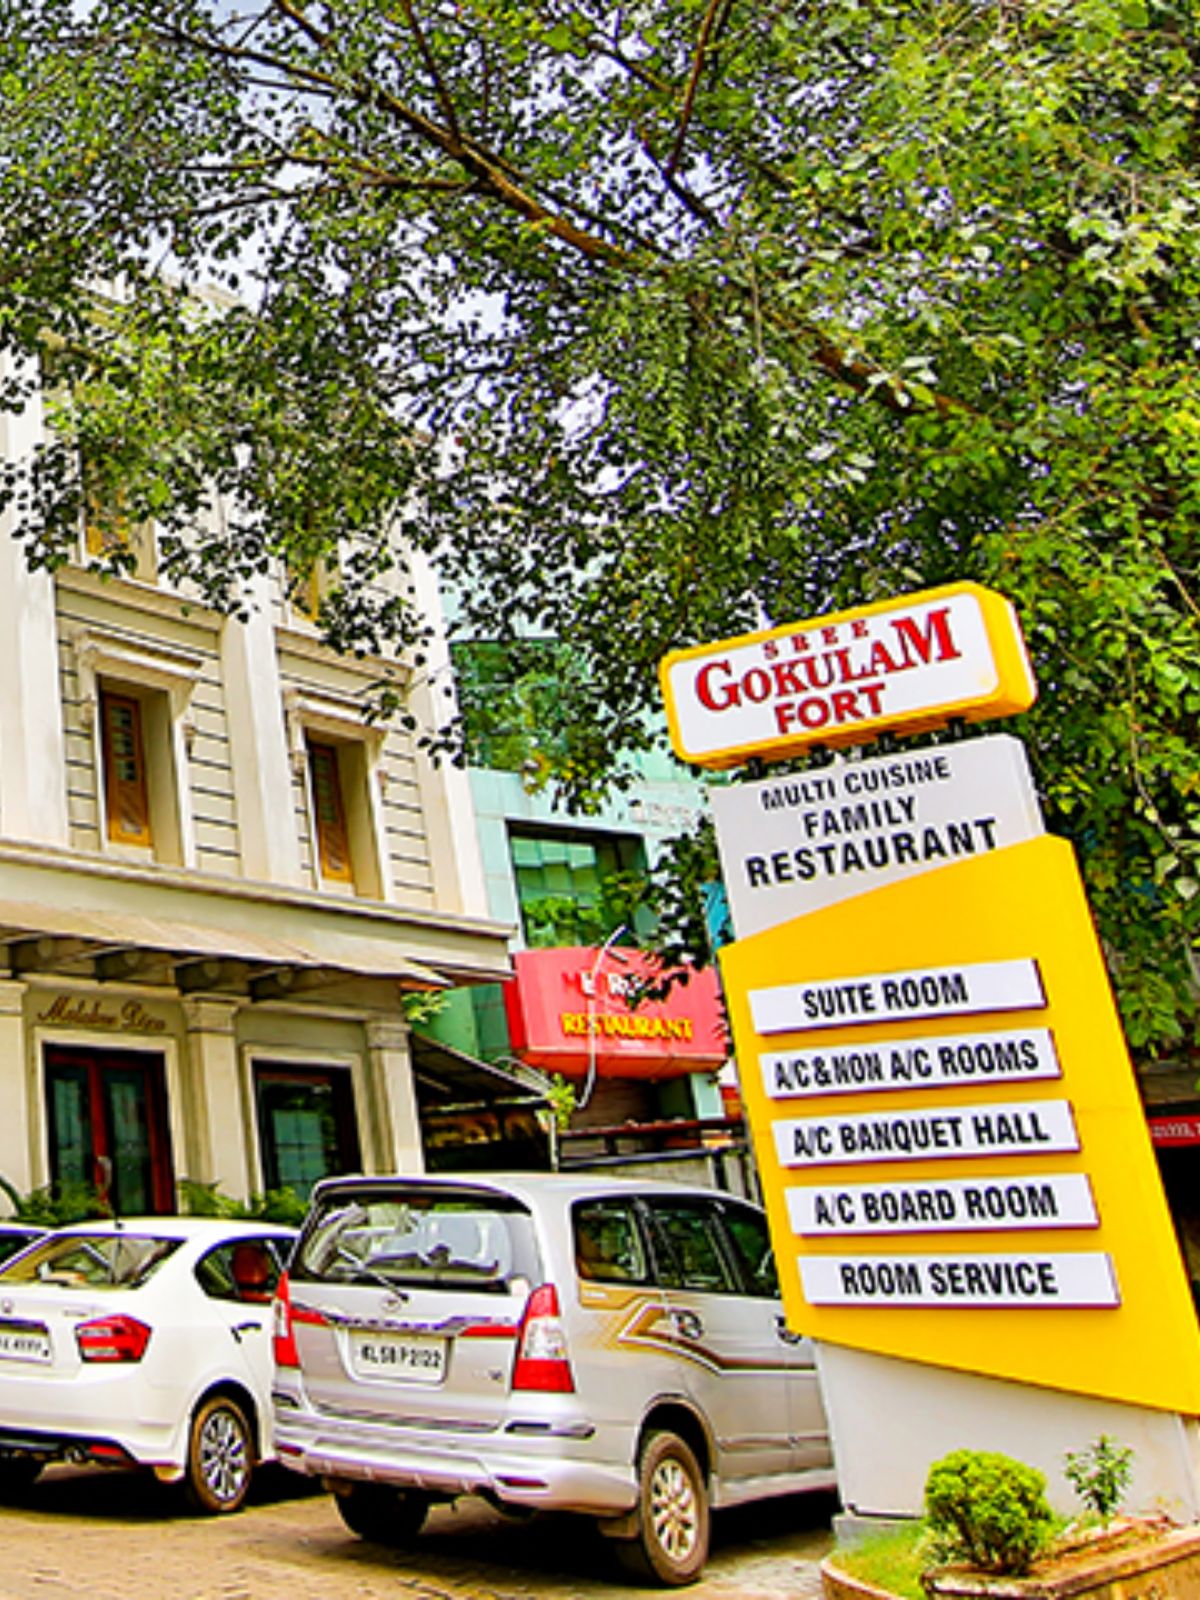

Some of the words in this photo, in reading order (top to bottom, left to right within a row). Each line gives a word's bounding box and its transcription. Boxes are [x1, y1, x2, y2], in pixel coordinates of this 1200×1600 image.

[695, 608, 961, 712] GOKULAM
[762, 620, 869, 660] SREE
[774, 684, 886, 734] FORT
[761, 779, 837, 811] MULTI
[844, 757, 951, 795] CUISINE
[803, 796, 917, 839] FAMILY
[745, 818, 998, 888] RESTAURANT
[802, 984, 877, 1018] SUITE
[882, 974, 969, 1010] ROOM
[890, 1048, 933, 1082] A/C
[938, 1039, 1040, 1075] ROOMS
[793, 1124, 834, 1159] A/C
[840, 1116, 963, 1153] BANQUET
[970, 1112, 1050, 1146] HALL
[815, 1193, 856, 1226] A/C
[863, 1189, 957, 1224] BOARD
[963, 1184, 1059, 1219] ROOM
[840, 1262, 922, 1296] ROOM
[929, 1261, 1059, 1296] SERVICE
